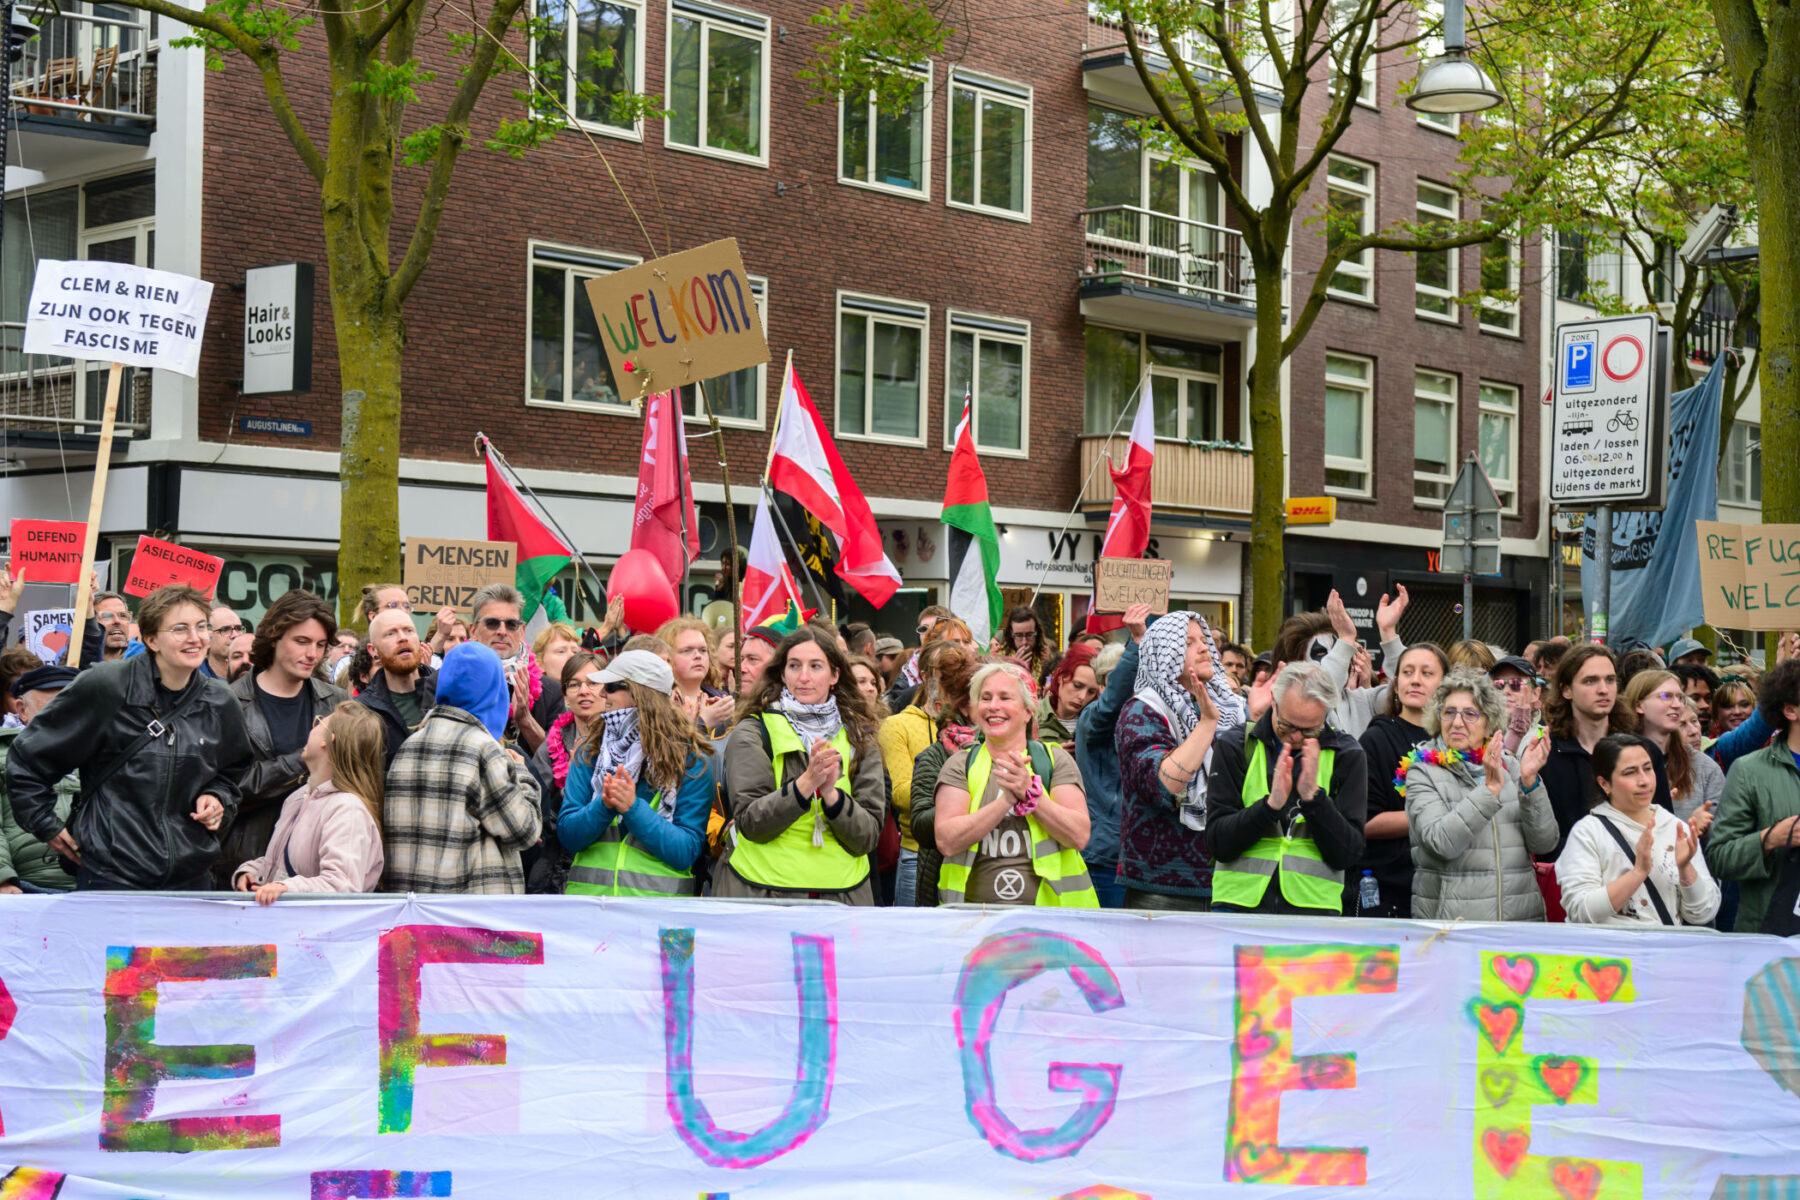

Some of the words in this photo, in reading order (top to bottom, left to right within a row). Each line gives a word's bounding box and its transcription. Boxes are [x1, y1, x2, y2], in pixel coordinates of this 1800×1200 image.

[61, 277, 110, 294] CLEM
[115, 281, 129, 296] &
[135, 284, 179, 304] RIEN
[39, 302, 82, 319] ZIJN
[88, 307, 131, 325] OOK
[140, 314, 197, 340] TEGEN
[249, 303, 281, 325] Hair
[282, 306, 290, 320] &
[602, 269, 750, 354] WELKOM
[248, 323, 292, 344] Looks
[1571, 333, 1591, 342] ZONE
[1572, 346, 1588, 369] P
[1565, 394, 1638, 410] uitgezonderd
[1561, 442, 1590, 452] laden
[1594, 439, 1601, 450] /
[1604, 439, 1639, 449] lossen
[1627, 452, 1633, 461] h
[1562, 464, 1635, 480] uitgezonderd
[1555, 481, 1591, 495] tijdens
[1594, 480, 1606, 490] de
[1610, 478, 1641, 490] markt
[1292, 507, 1323, 515] DHL
[28, 531, 77, 543] DEFEND
[19, 551, 84, 563] HUMANITY
[142, 544, 216, 573] ASIELCRISIS
[418, 544, 509, 568] MENSEN
[1026, 560, 1073, 573] Professional
[1074, 562, 1088, 573] Nail
[426, 564, 491, 585] GEEN
[1101, 562, 1169, 580] VLUCHTELINGEN
[406, 585, 478, 607] GRENZ
[1103, 585, 1166, 606] WELKOM
[33, 612, 75, 633] SAMEN
